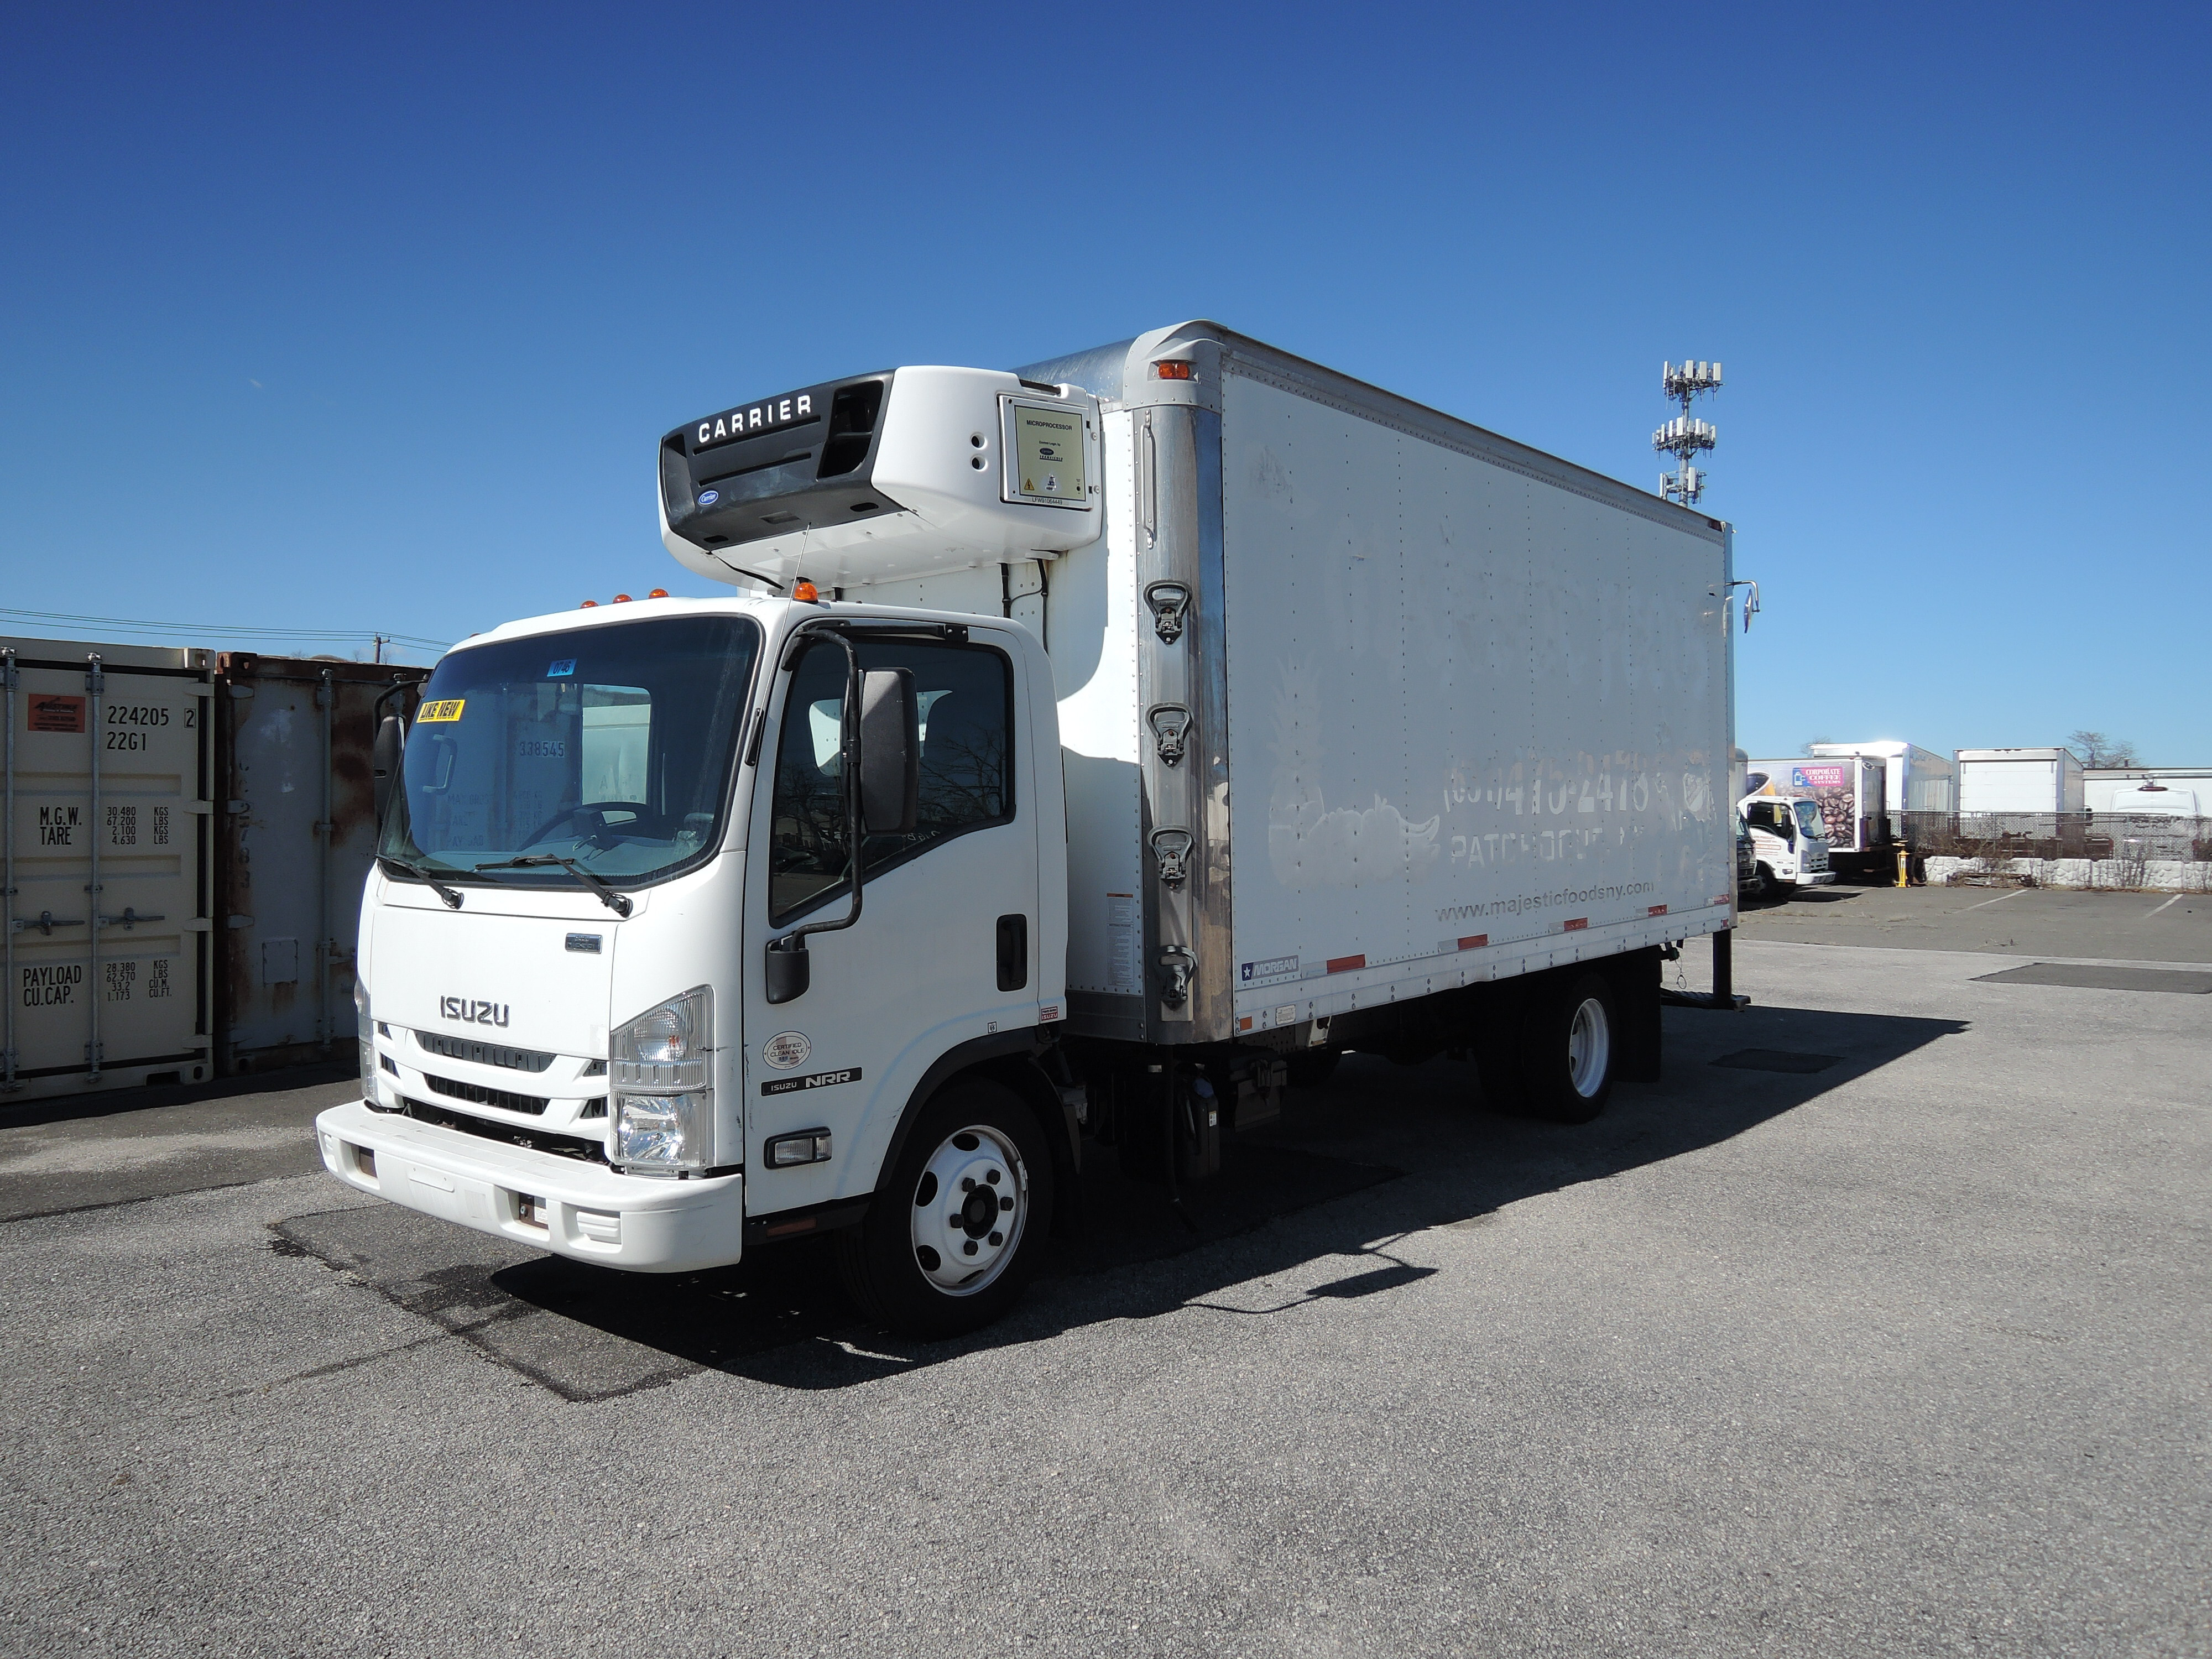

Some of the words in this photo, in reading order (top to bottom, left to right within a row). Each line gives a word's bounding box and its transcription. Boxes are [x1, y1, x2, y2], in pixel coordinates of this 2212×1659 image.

[698, 394, 811, 443] CARRIER
[1026, 420, 1072, 430] MICROPROCESSOR
[108, 706, 169, 726] 224205
[186, 709, 195, 727] 2
[436, 701, 461, 719] NEW
[107, 731, 146, 751] 22G1
[519, 741, 565, 758] 338545
[40, 807, 82, 826] M.G.W.
[107, 807, 136, 816] 30.480
[154, 807, 169, 816] KGS
[107, 816, 136, 826] 67.200
[154, 816, 169, 826] LBS
[40, 826, 72, 845] TARE
[112, 826, 136, 836] 2.100
[154, 826, 169, 835] KGS
[112, 835, 136, 845] 4.630
[154, 835, 169, 844] LBS
[1434, 881, 1654, 922] www.majesticfoodsny.com
[107, 962, 135, 973] 28.380
[154, 960, 168, 969] KGS
[107, 972, 135, 982] 62.570
[154, 969, 168, 979] LBS
[1253, 958, 1298, 976] MORGAN
[23, 965, 81, 988] PAYLOAD
[24, 985, 74, 1006] CU.CAP.
[112, 982, 130, 992] 33.2
[440, 995, 509, 1028] ISUZU
[773, 1042, 801, 1051] CERTIFIED
[771, 1081, 797, 1091] ISUZU
[805, 1071, 851, 1088] NRR
